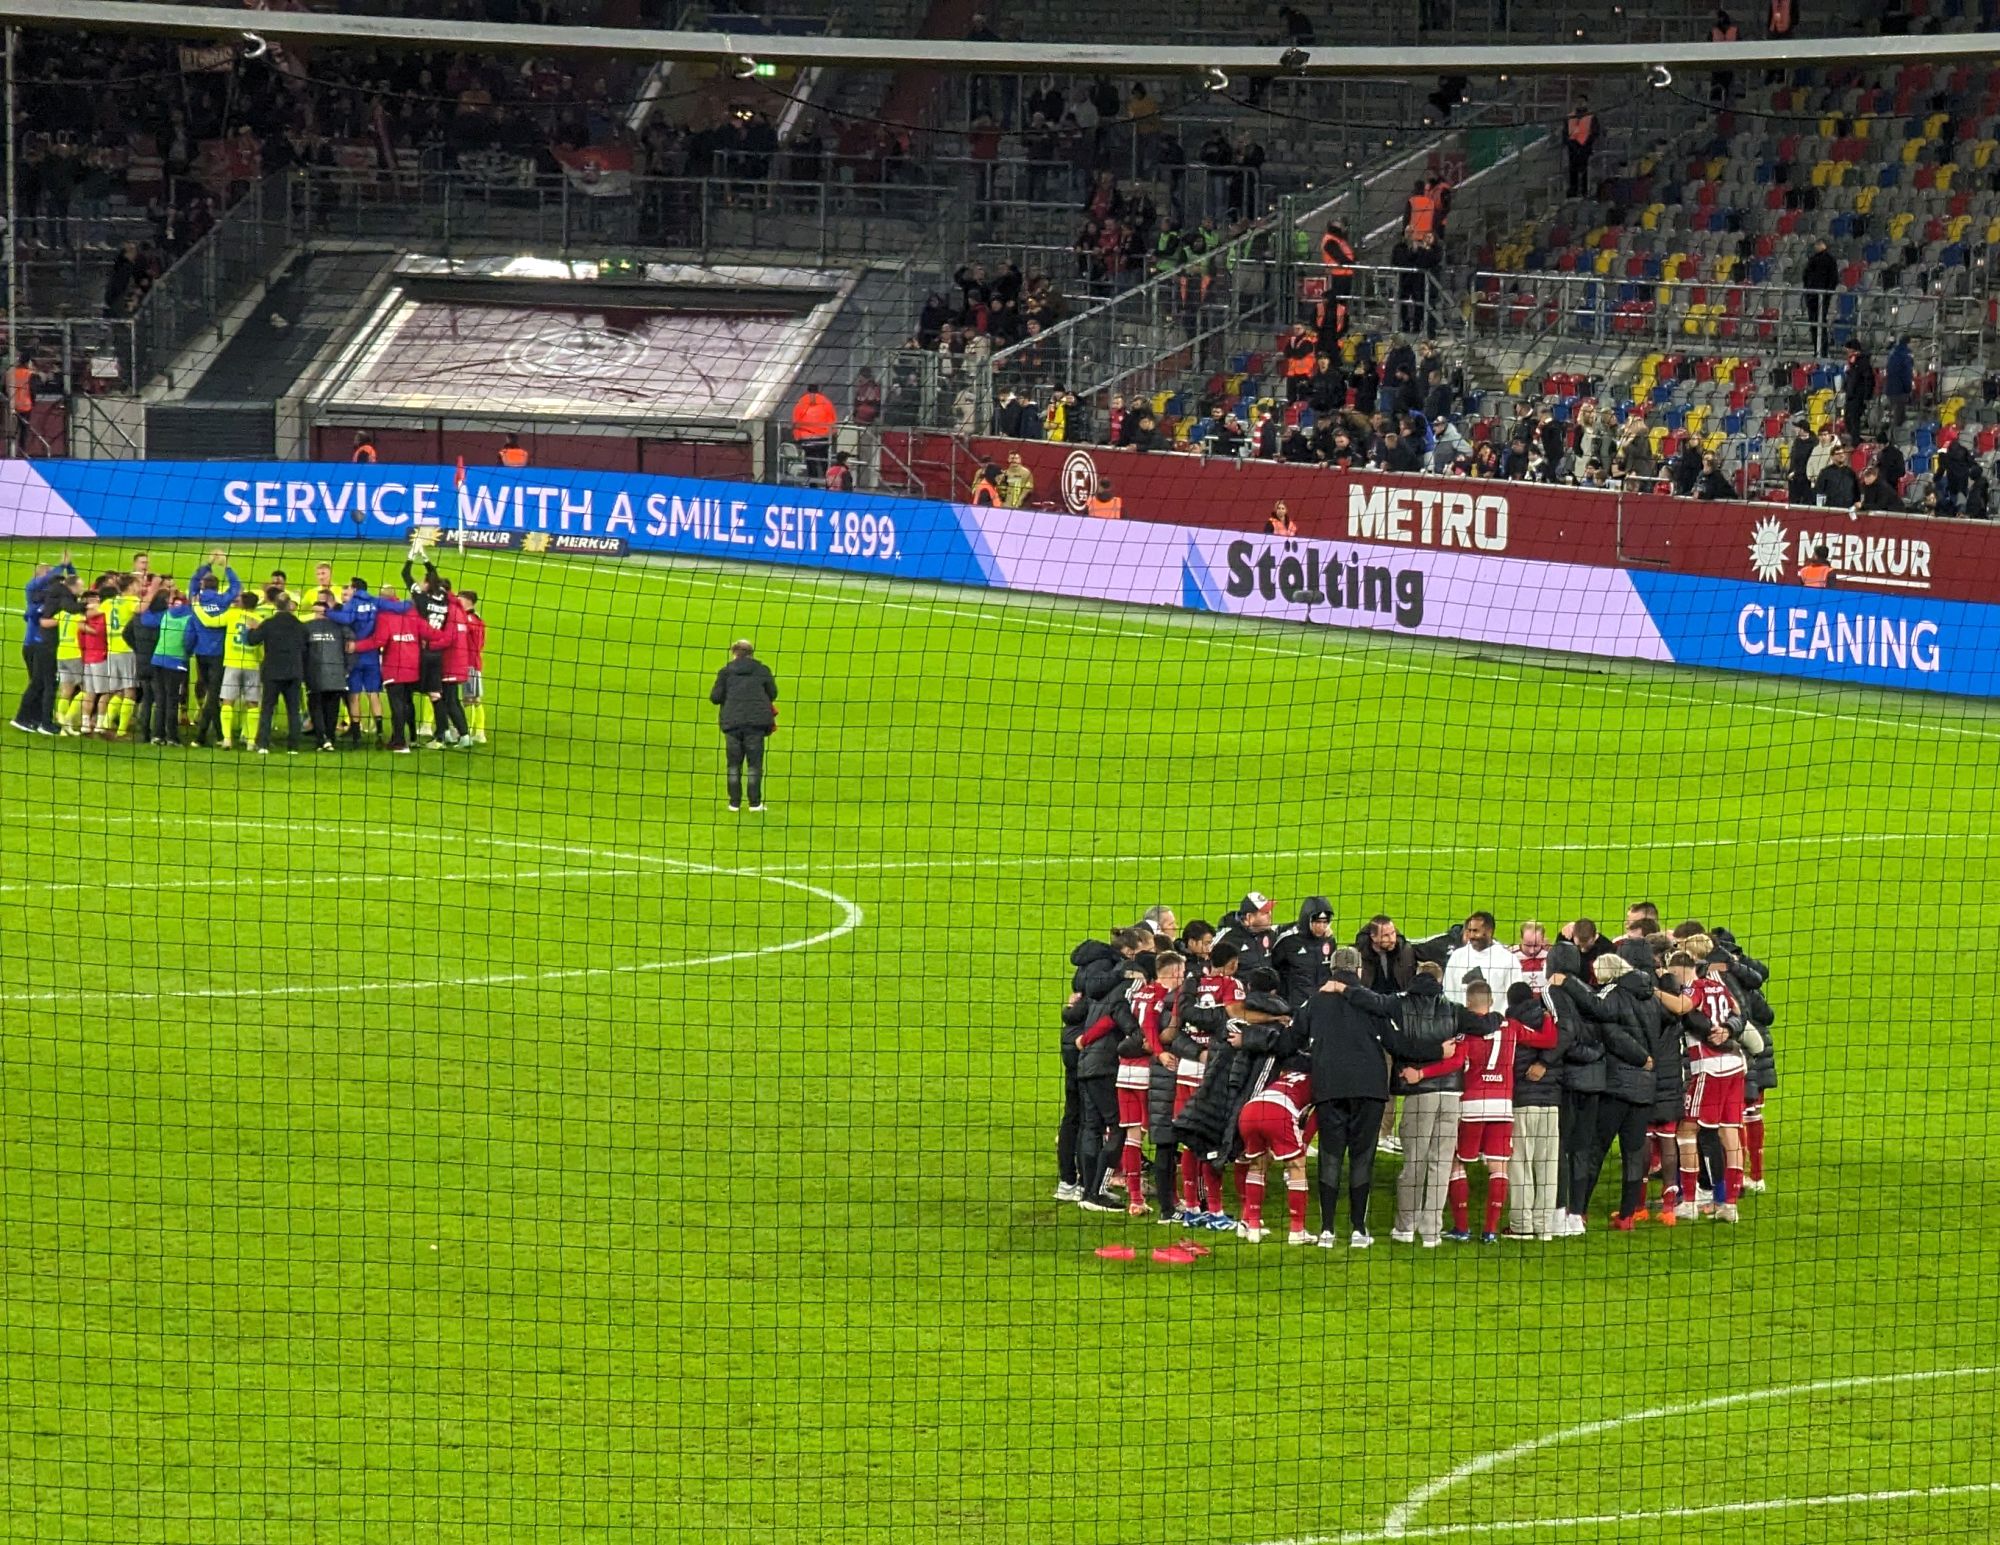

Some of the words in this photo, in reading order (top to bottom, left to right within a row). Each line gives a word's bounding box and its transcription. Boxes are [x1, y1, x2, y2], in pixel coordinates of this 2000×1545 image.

[223, 480, 440, 526] SERVICE
[459, 484, 592, 531] WITH
[605, 491, 637, 534] A
[646, 493, 754, 545] SMILE.
[764, 503, 823, 551] SEIT
[829, 510, 902, 560] 1899.
[446, 529, 511, 544] MERKUR
[555, 535, 620, 550] MERKUR
[1348, 484, 1509, 551] METRO
[1797, 530, 1931, 577] MERKUR
[1226, 540, 1424, 628] Stölting
[1738, 603, 1939, 672] CLEANING
[1483, 1030, 1502, 1070] 7
